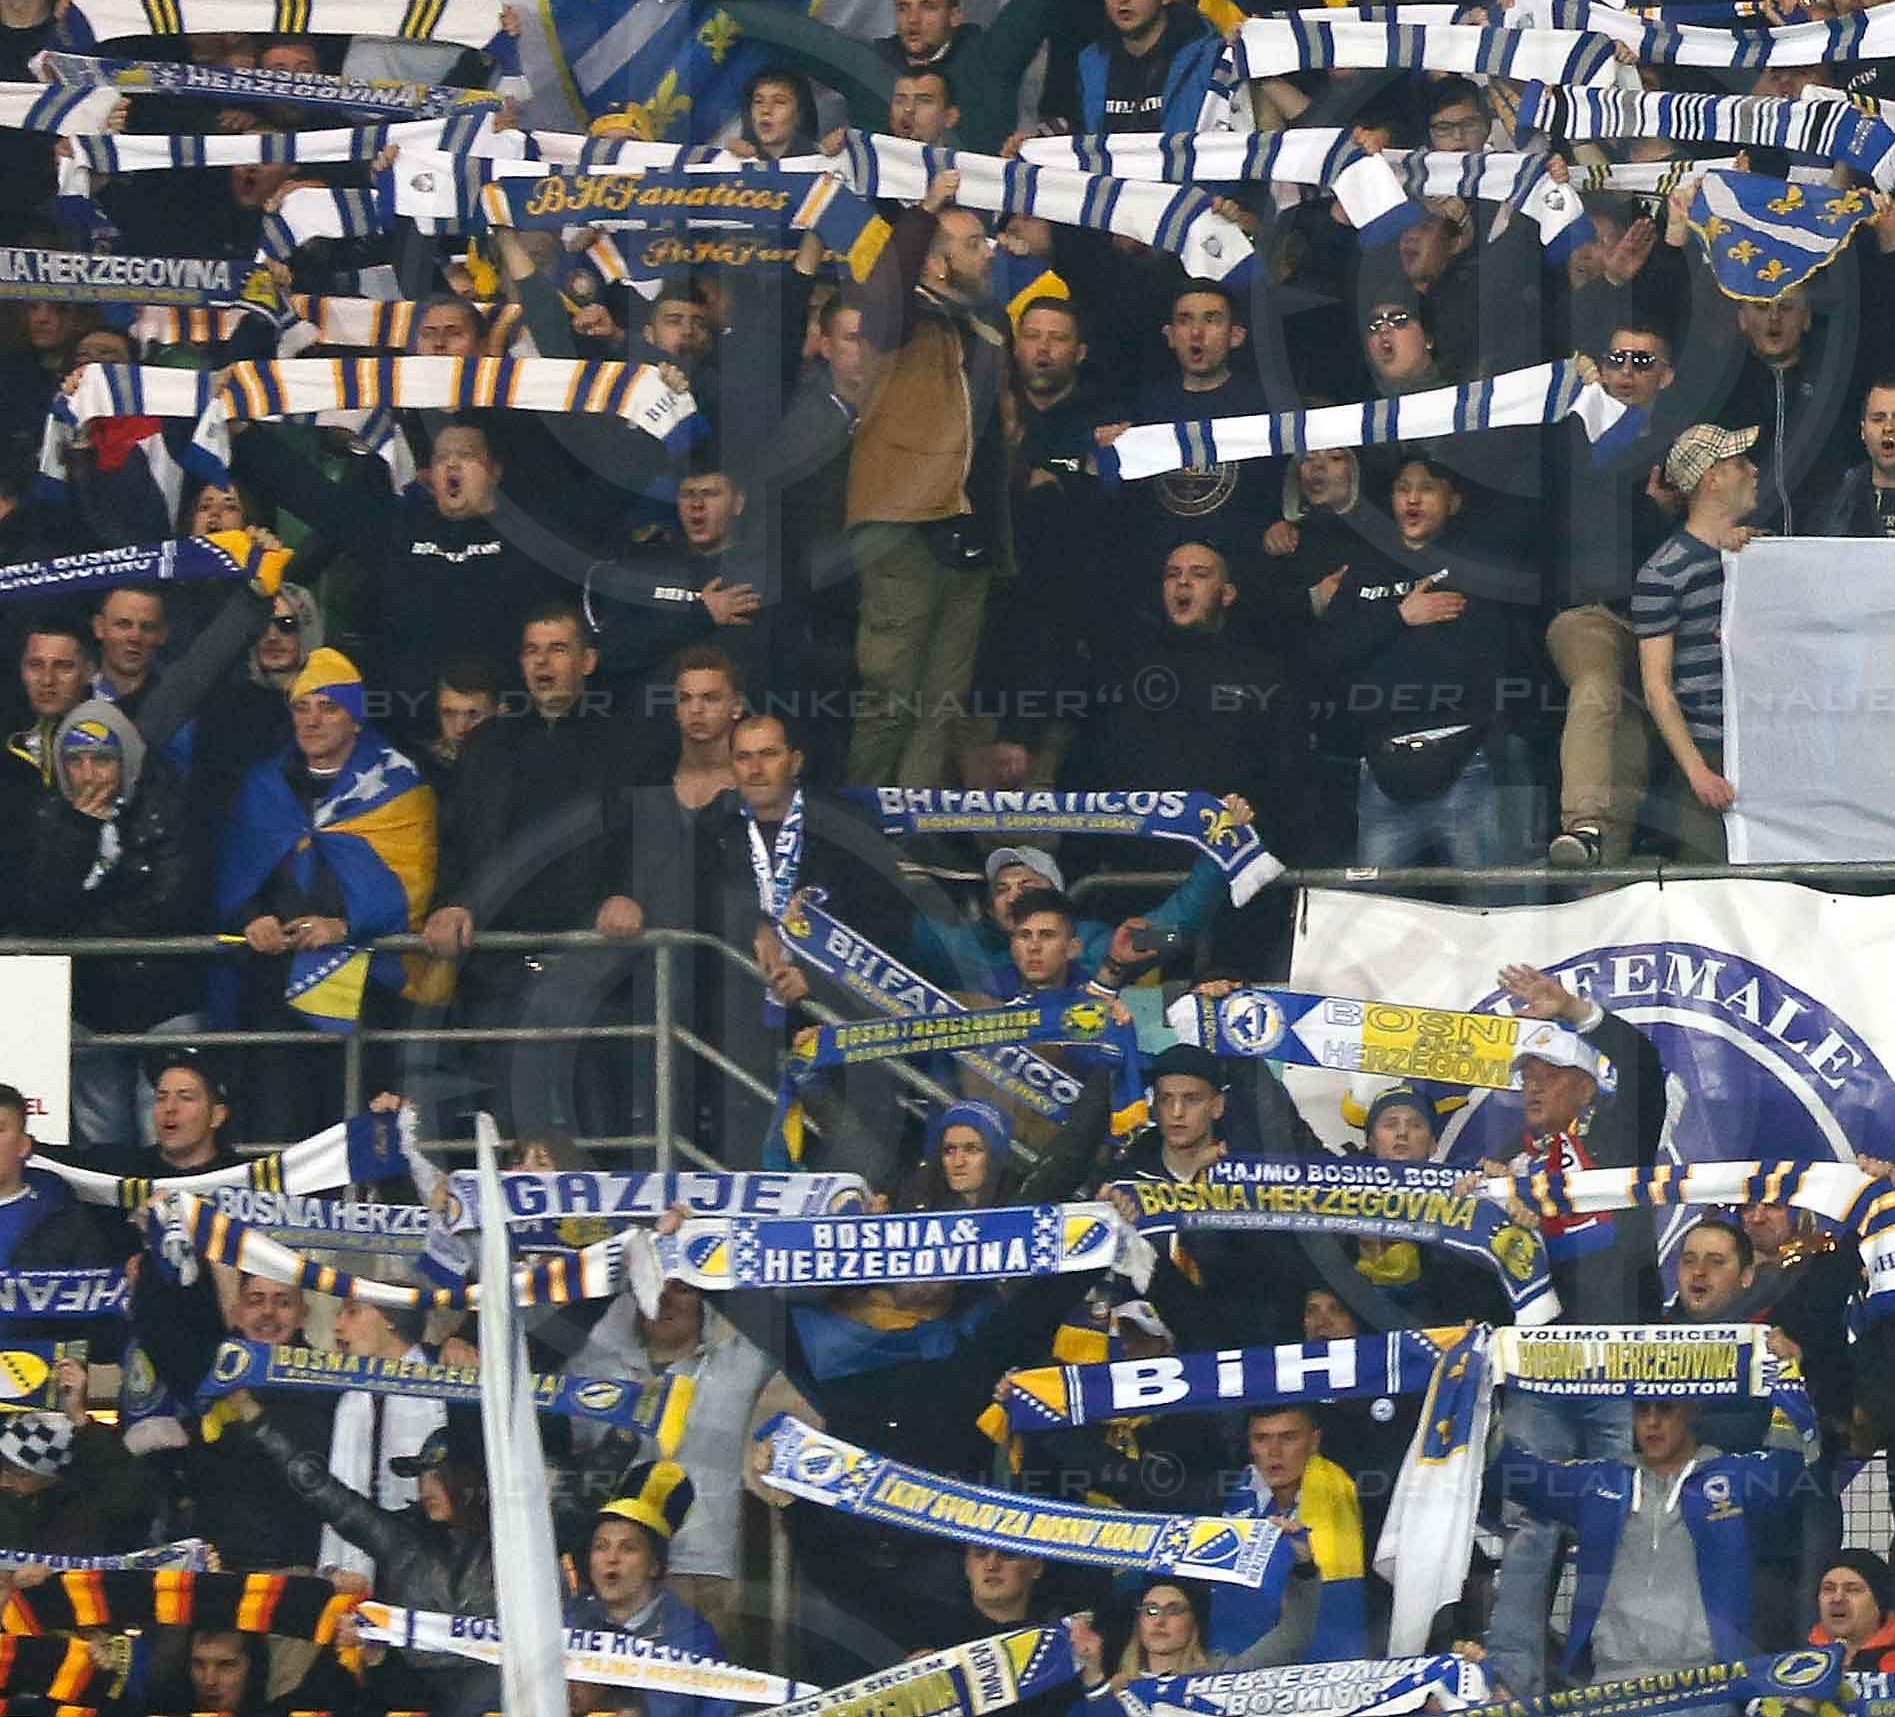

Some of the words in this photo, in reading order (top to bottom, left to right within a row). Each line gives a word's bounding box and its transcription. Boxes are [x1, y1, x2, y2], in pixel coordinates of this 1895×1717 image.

[526, 172, 791, 217] BHFanaticos
[39, 252, 231, 292] HERZEGOVINA
[1322, 1041, 1511, 1088] HERZEGOVI
[501, 1172, 791, 1218] GAZIJE
[1136, 1181, 1250, 1216] BOSNIA
[1256, 1185, 1479, 1231] HERZEGOVINA
[812, 1221, 948, 1253] BOSNIA
[951, 1218, 981, 1243] &
[762, 1237, 1030, 1283] HERZEGOVINA
[1109, 1339, 1357, 1409] BiH
